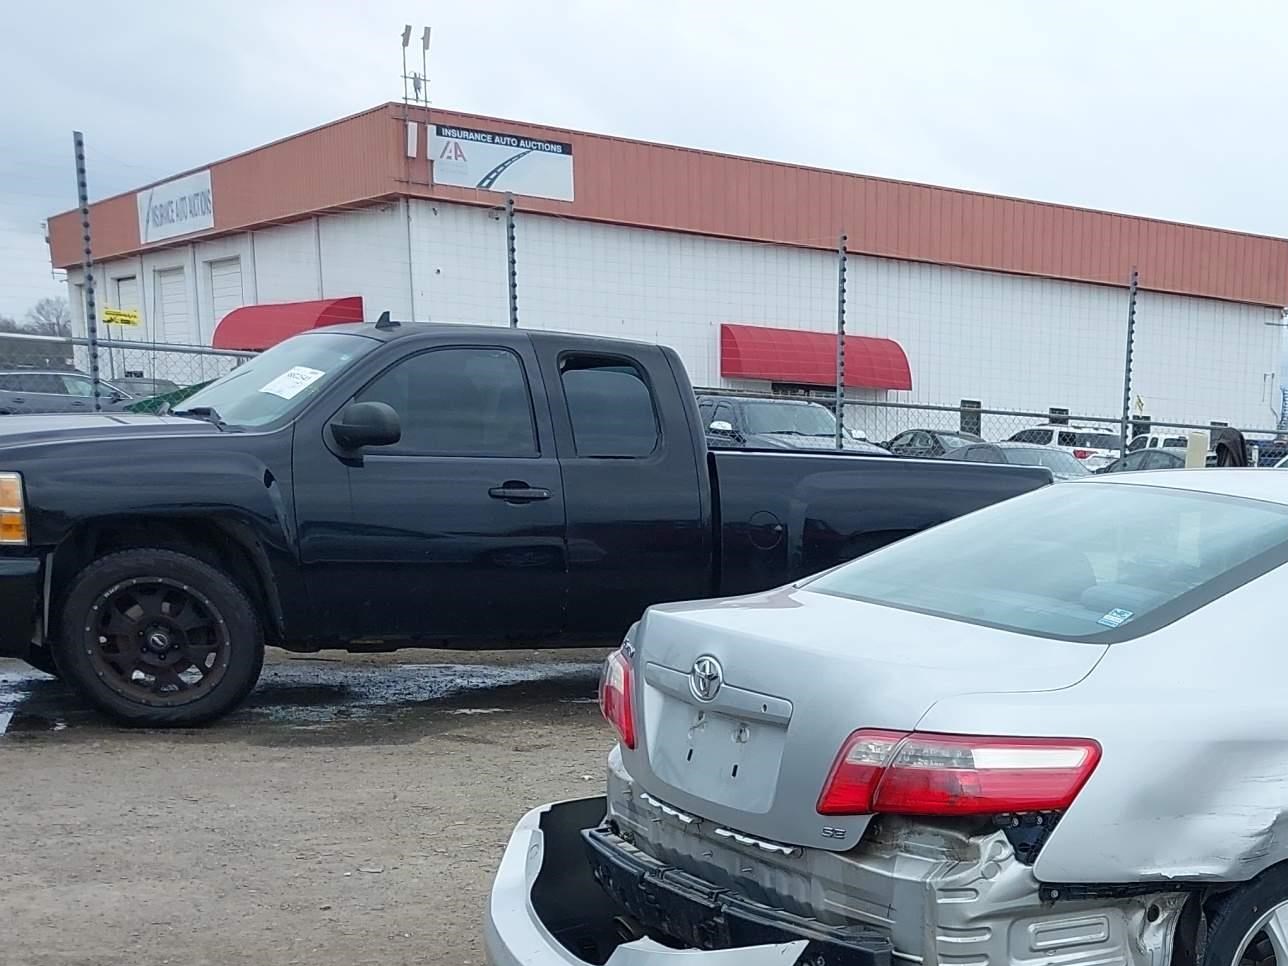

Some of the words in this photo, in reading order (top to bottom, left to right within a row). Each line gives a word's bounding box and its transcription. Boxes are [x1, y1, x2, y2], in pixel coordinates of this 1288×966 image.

[441, 127, 493, 143] INSURANCE
[494, 135, 519, 147] AUTO
[519, 140, 563, 154] AUCTIONS
[821, 825, 847, 840] SE
